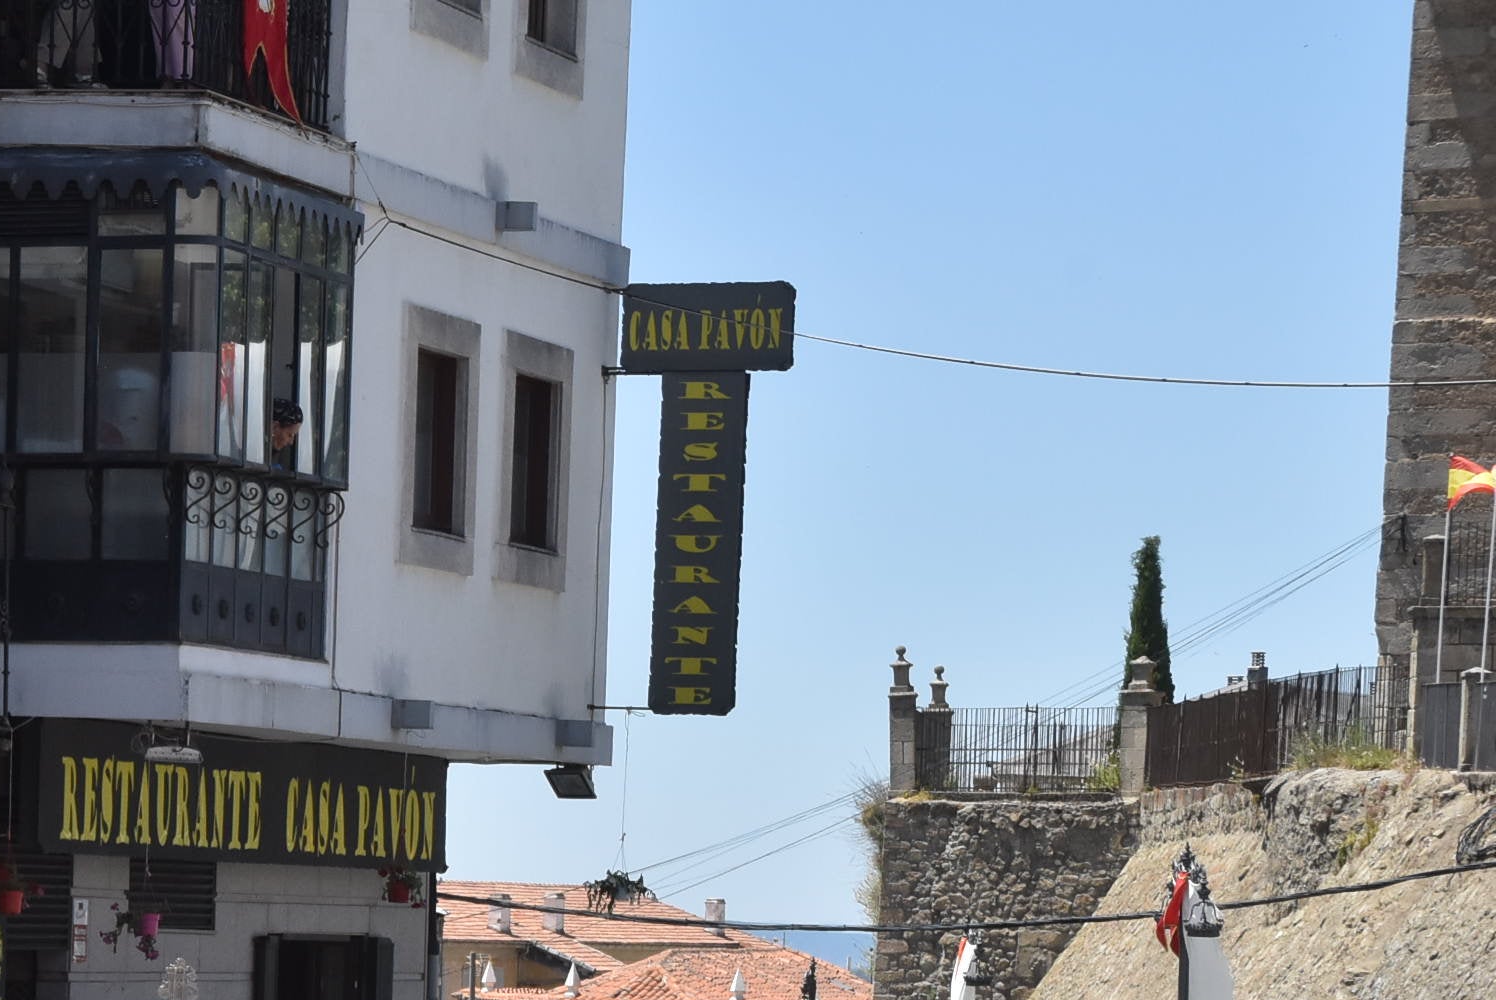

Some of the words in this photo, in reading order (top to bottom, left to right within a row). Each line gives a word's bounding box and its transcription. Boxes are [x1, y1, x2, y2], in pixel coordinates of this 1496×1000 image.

[629, 308, 690, 352] CASA
[698, 294, 784, 352] PAVÓN
[665, 381, 732, 705] RESTAURANTE
[59, 755, 262, 850] RESTAURANTE
[286, 777, 347, 857] CASA
[354, 765, 436, 861] PAVÓN
